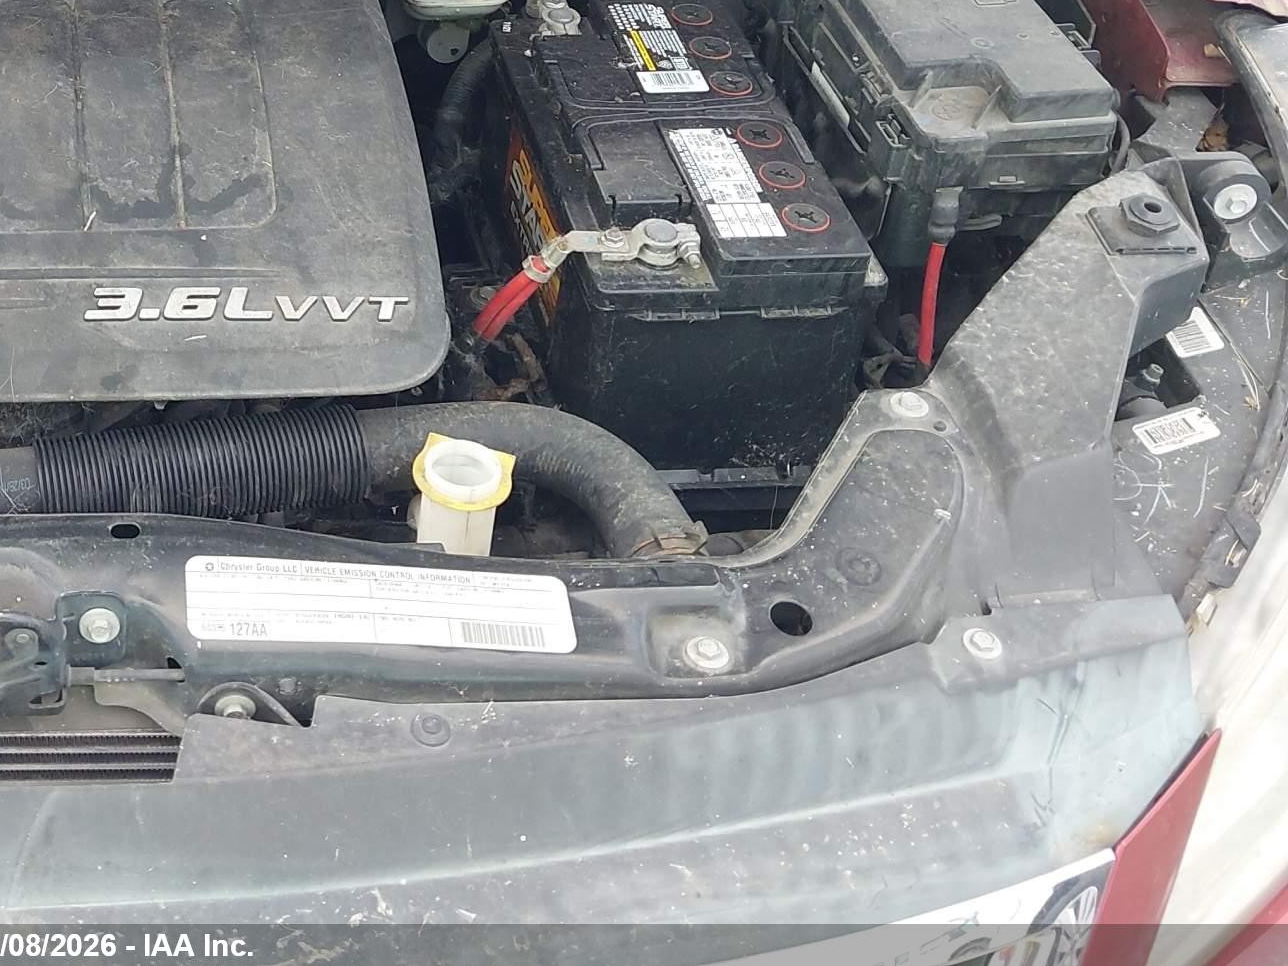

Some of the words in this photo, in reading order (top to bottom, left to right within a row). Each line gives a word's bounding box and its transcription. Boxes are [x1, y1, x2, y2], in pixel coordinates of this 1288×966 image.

[220, 562, 253, 572] Chrysler
[256, 562, 279, 573] Group
[282, 565, 298, 573] LLC
[304, 566, 337, 576] VEHICLE
[340, 568, 377, 578] EMISSION
[379, 570, 414, 580] CONTROL
[417, 573, 471, 584] INFORMATION
[230, 622, 268, 637] 127AA
